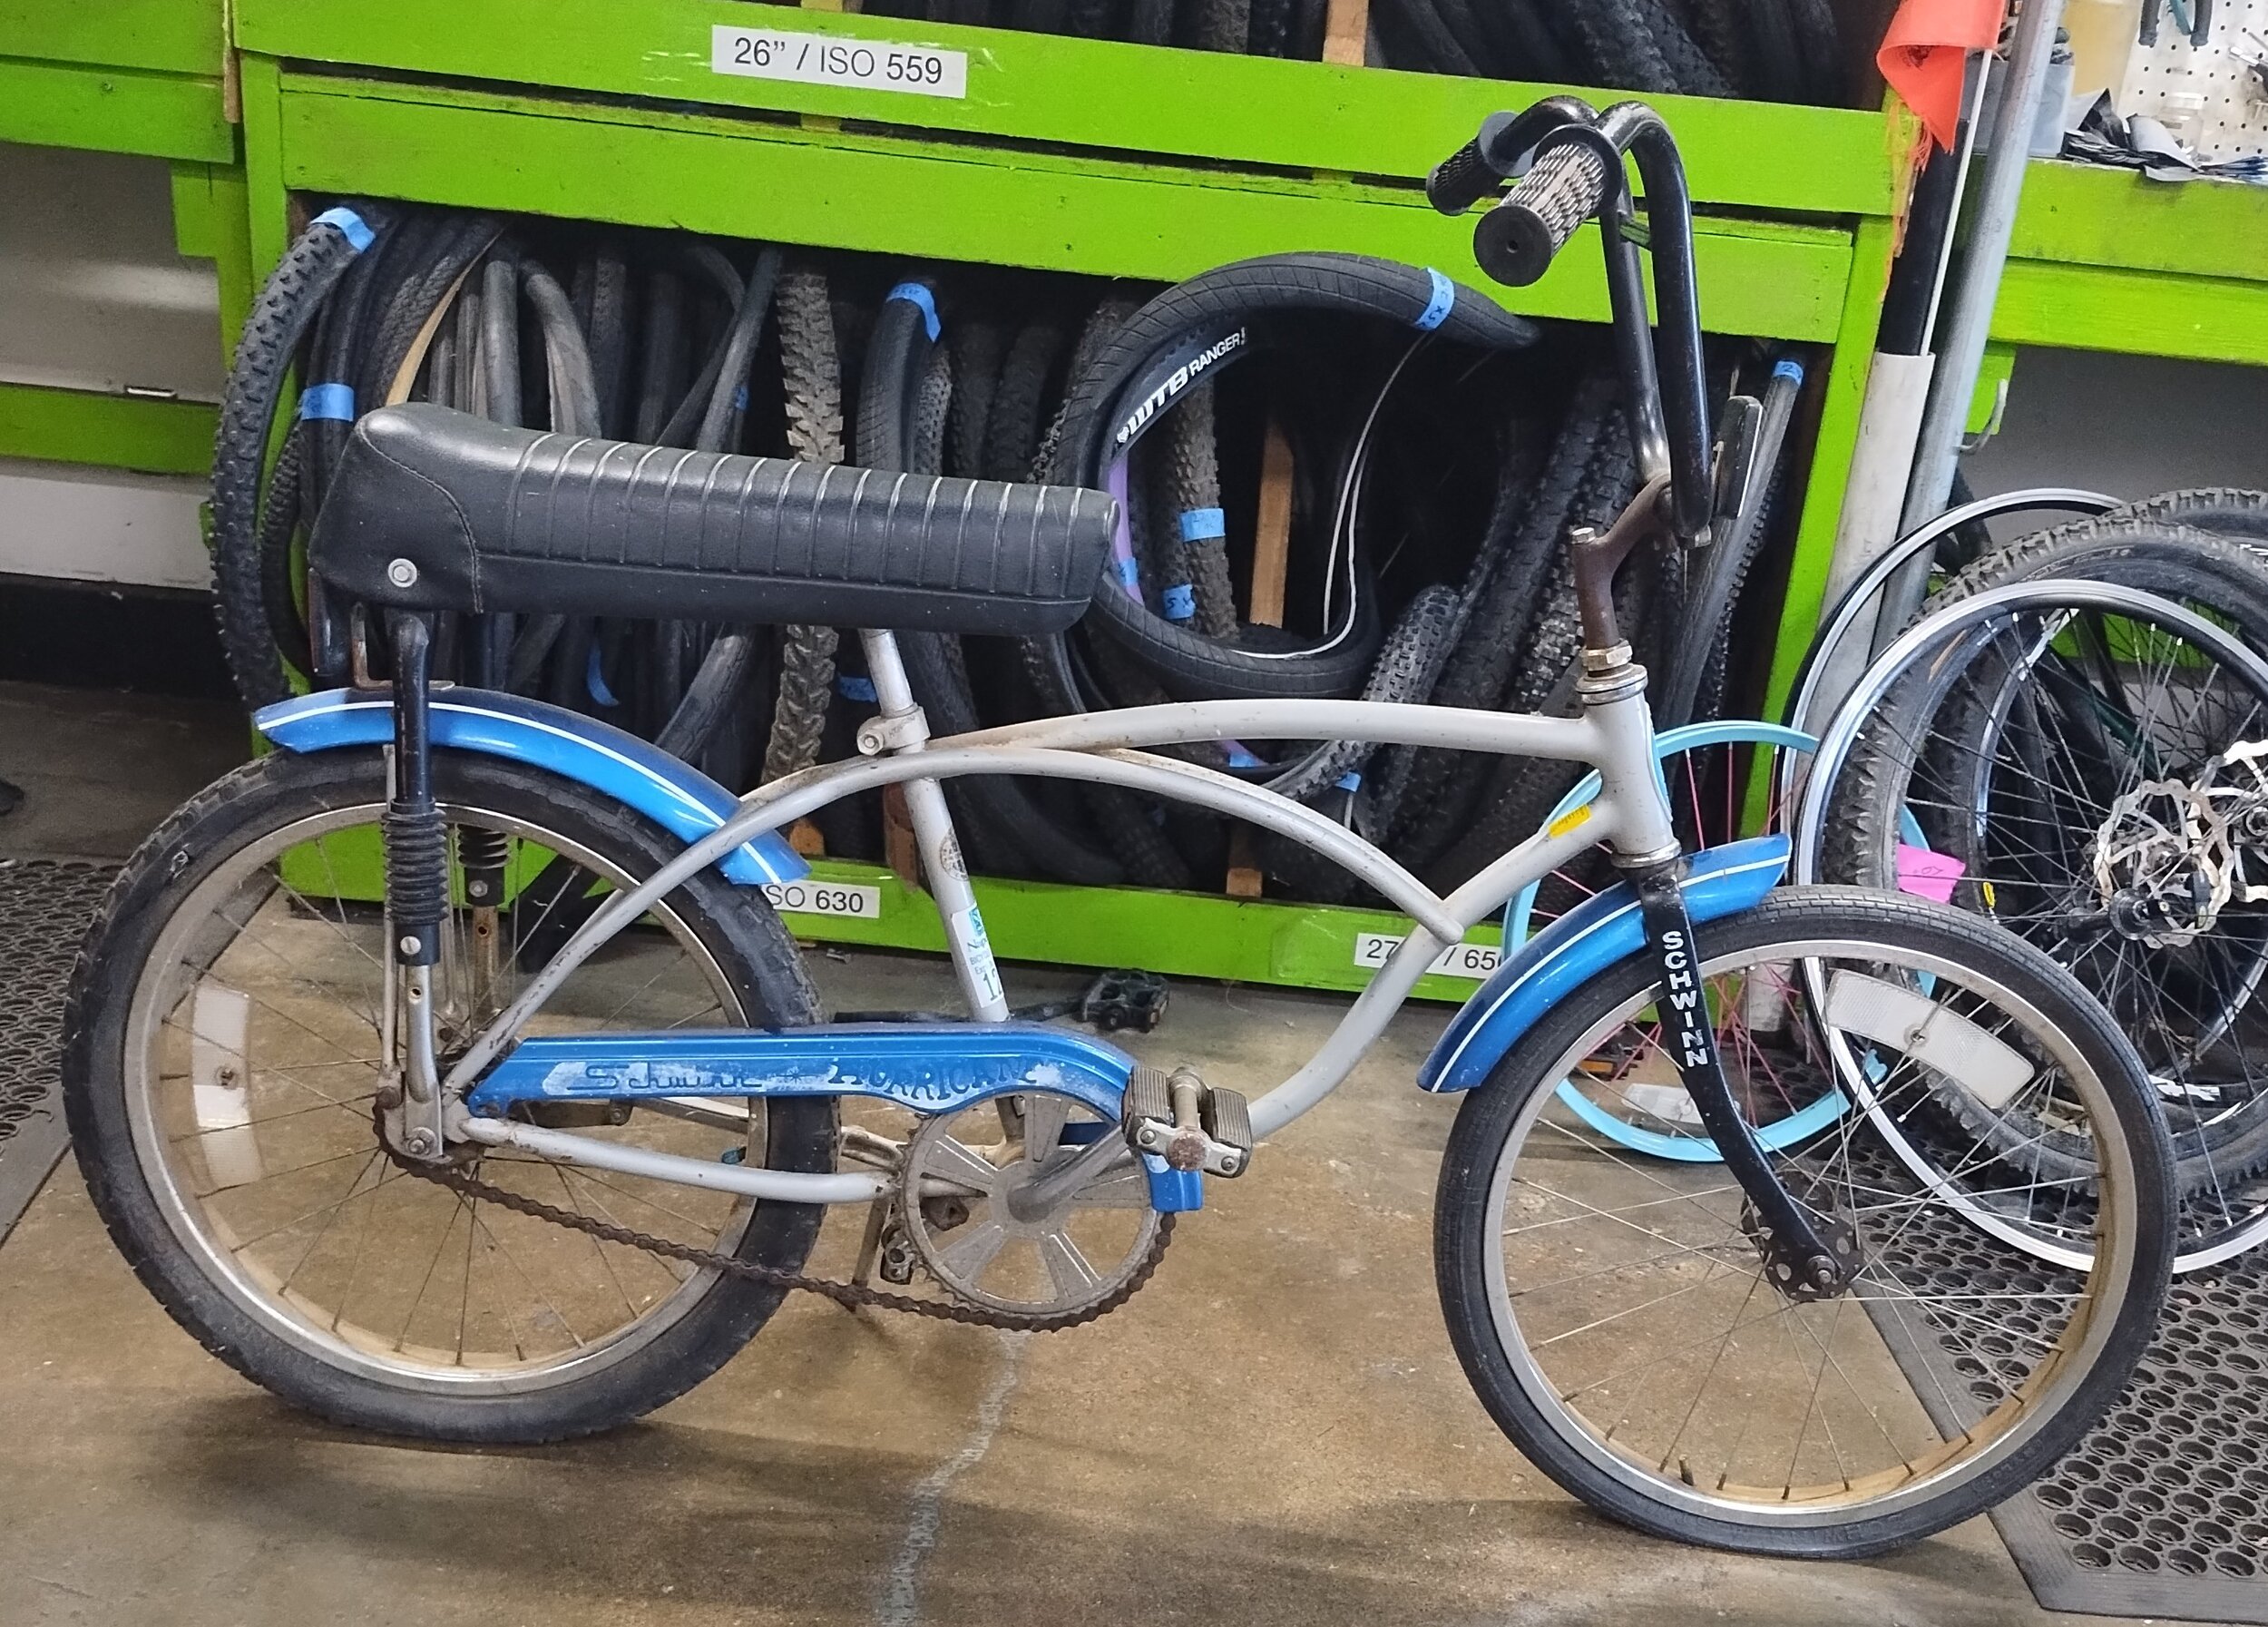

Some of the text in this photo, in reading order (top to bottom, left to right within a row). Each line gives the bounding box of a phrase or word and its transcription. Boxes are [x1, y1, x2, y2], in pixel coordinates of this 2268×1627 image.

[796, 43, 809, 71] /
[820, 45, 875, 77] ISO
[885, 53, 943, 84] 559
[1128, 366, 1188, 436] WTB
[765, 884, 864, 913] SO 630
[1463, 949, 1502, 971] 65
[1662, 930, 1708, 1067] SCHWINN
